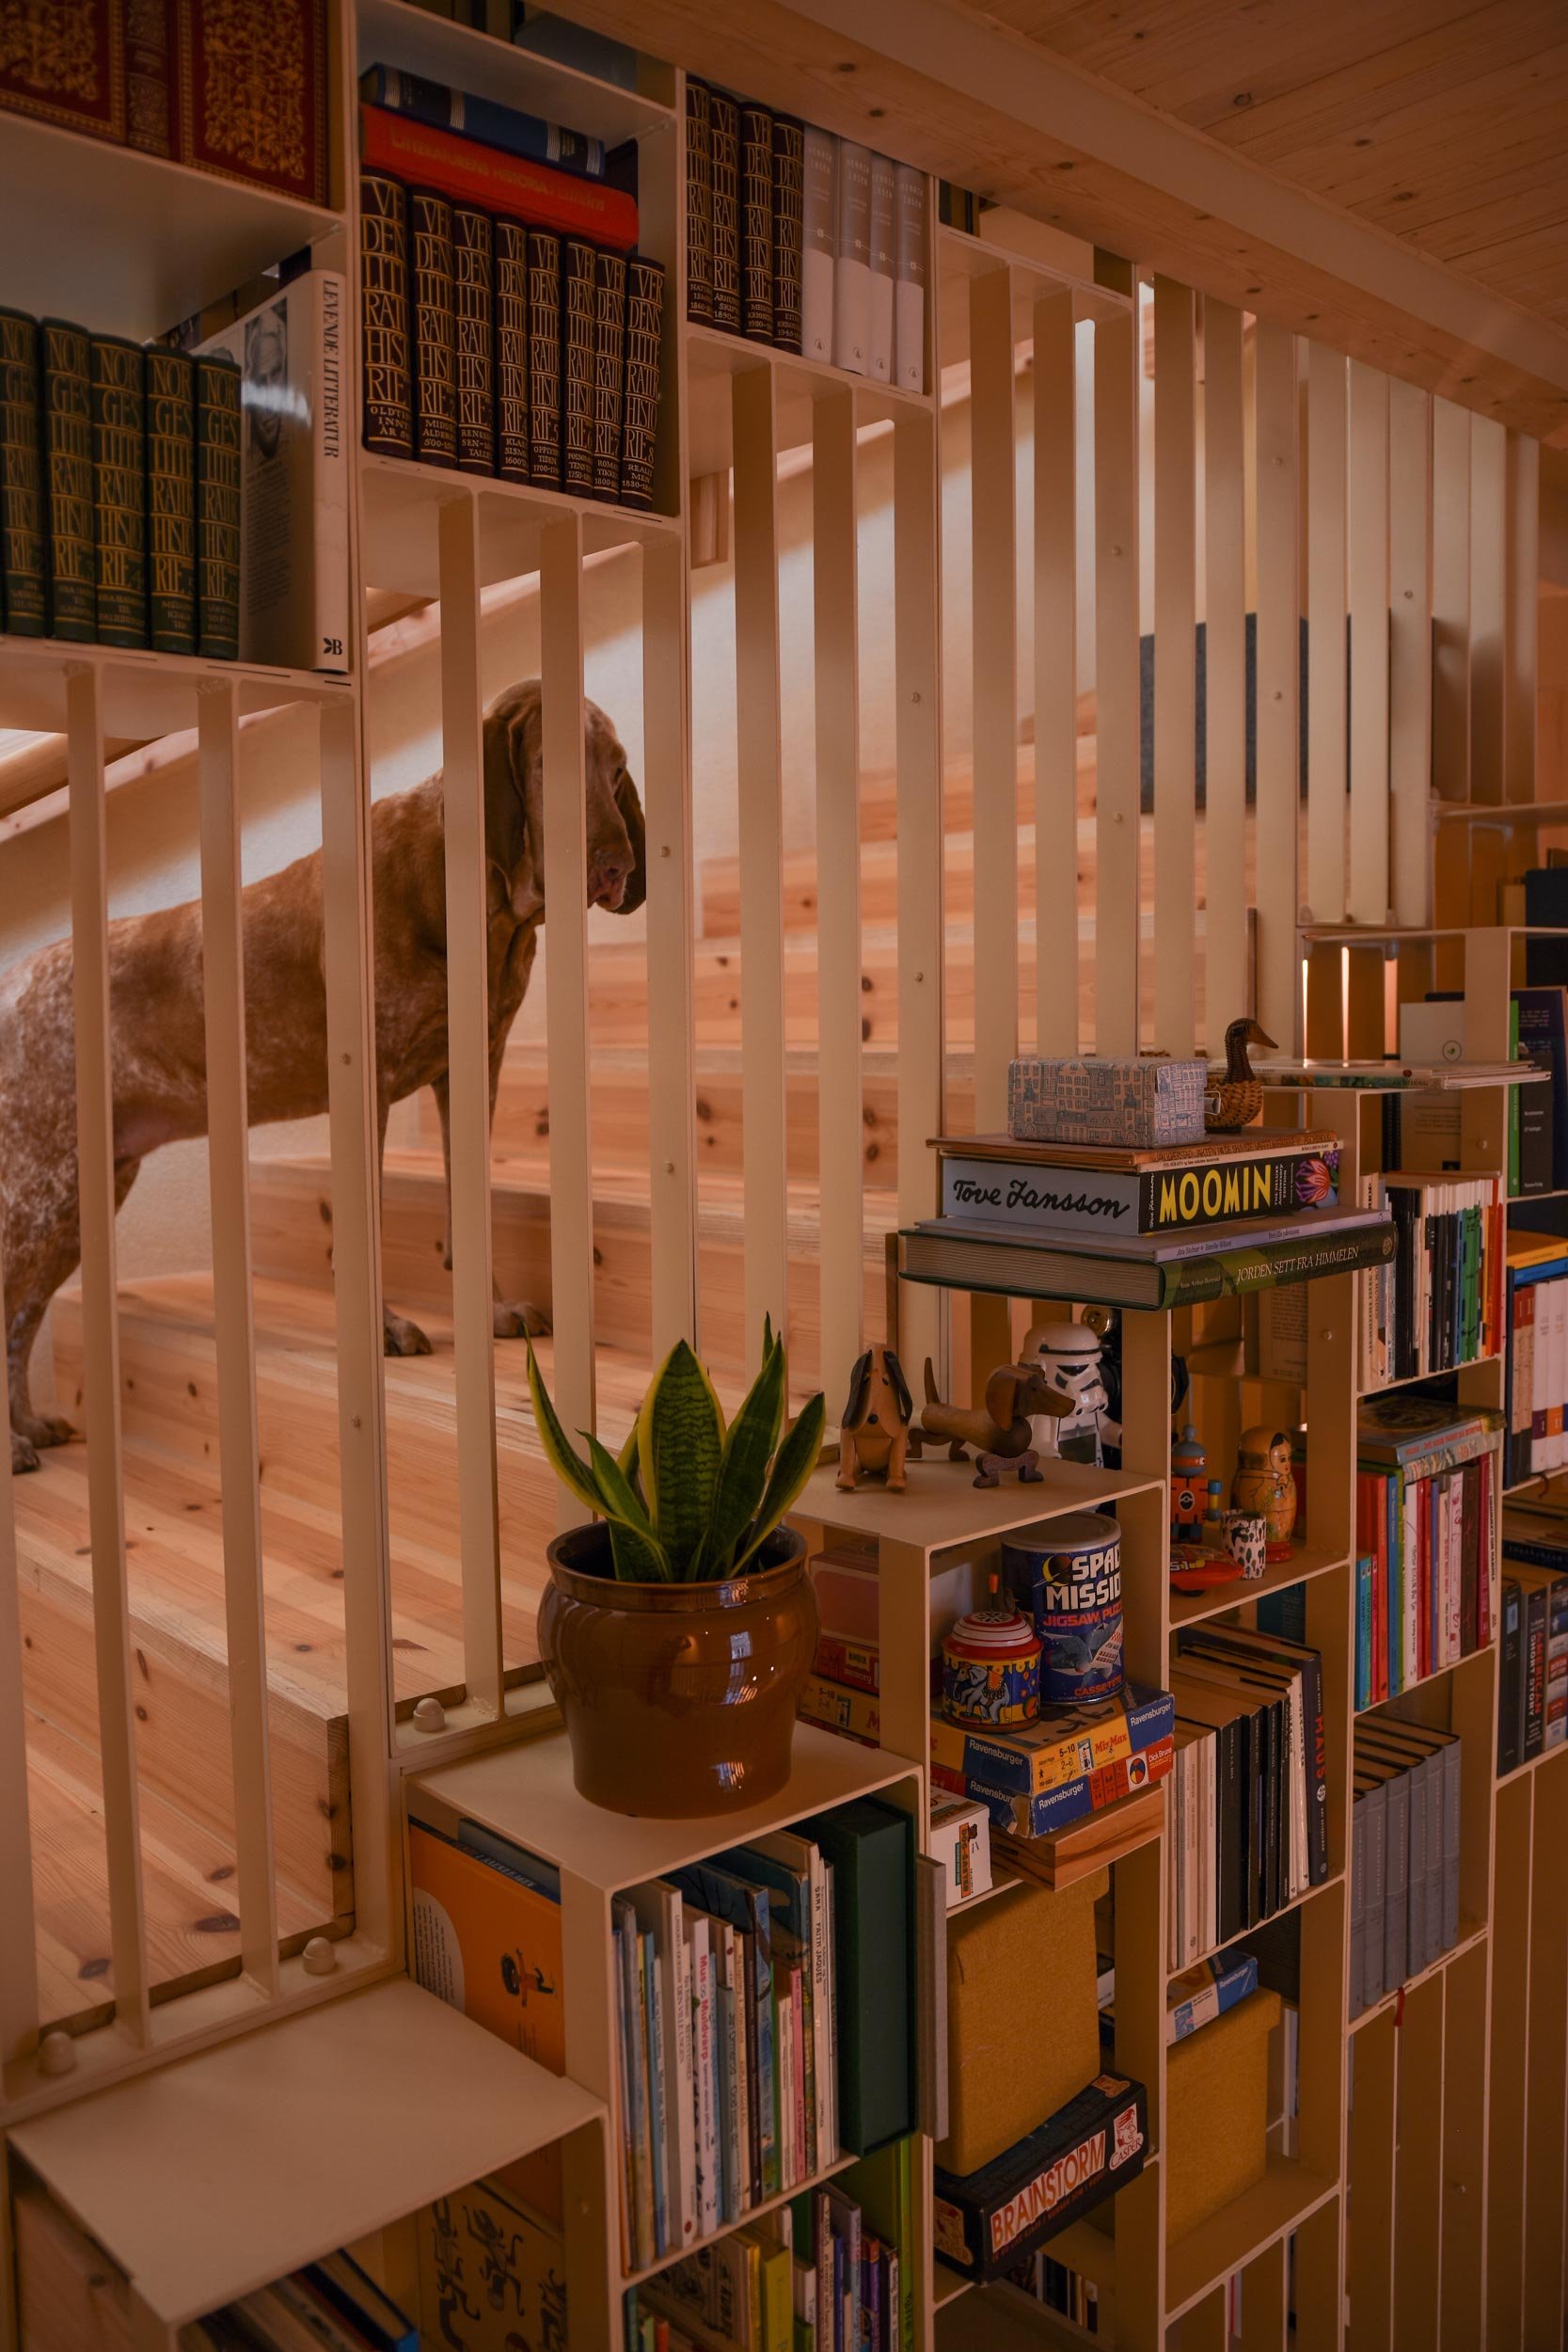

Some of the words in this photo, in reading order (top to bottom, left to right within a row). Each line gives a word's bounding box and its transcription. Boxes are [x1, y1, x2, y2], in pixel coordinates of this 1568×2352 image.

[372, 183, 404, 220] VE
[363, 218, 405, 258] DEN
[417, 236, 453, 276] DEN
[458, 249, 492, 289] DEN
[324, 279, 339, 354] LEVENDE
[324, 358, 339, 458] LITTERATUR
[953, 1180, 1001, 1206] Tove
[1006, 1179, 1131, 1219] Jansson
[1159, 1164, 1272, 1224] MOOMIN
[1236, 1263, 1272, 1285] JORDEN
[1274, 1259, 1295, 1275] SETT
[1296, 1254, 1314, 1271] FRA
[1315, 1246, 1359, 1267] HIMMELEN
[1072, 1543, 1121, 1581] SPAC
[1046, 1572, 1121, 1611] MISSIO
[1043, 1611, 1100, 1627] JIGSAW
[1102, 1600, 1122, 1620] PUZZ
[1131, 1702, 1171, 1727] Ravensburger
[969, 1739, 1023, 1766] Ravensburger
[1148, 1752, 1159, 1763] Dick
[1313, 1715, 1325, 1781] MAUS
[970, 1780, 1015, 1804] Ravensbur
[1038, 1782, 1085, 1810] Ravensburger
[701, 1999, 710, 2059] Muldvarp
[1111, 2137, 1141, 2169] CASPER
[991, 2132, 1105, 2252] BRAINSTORM
